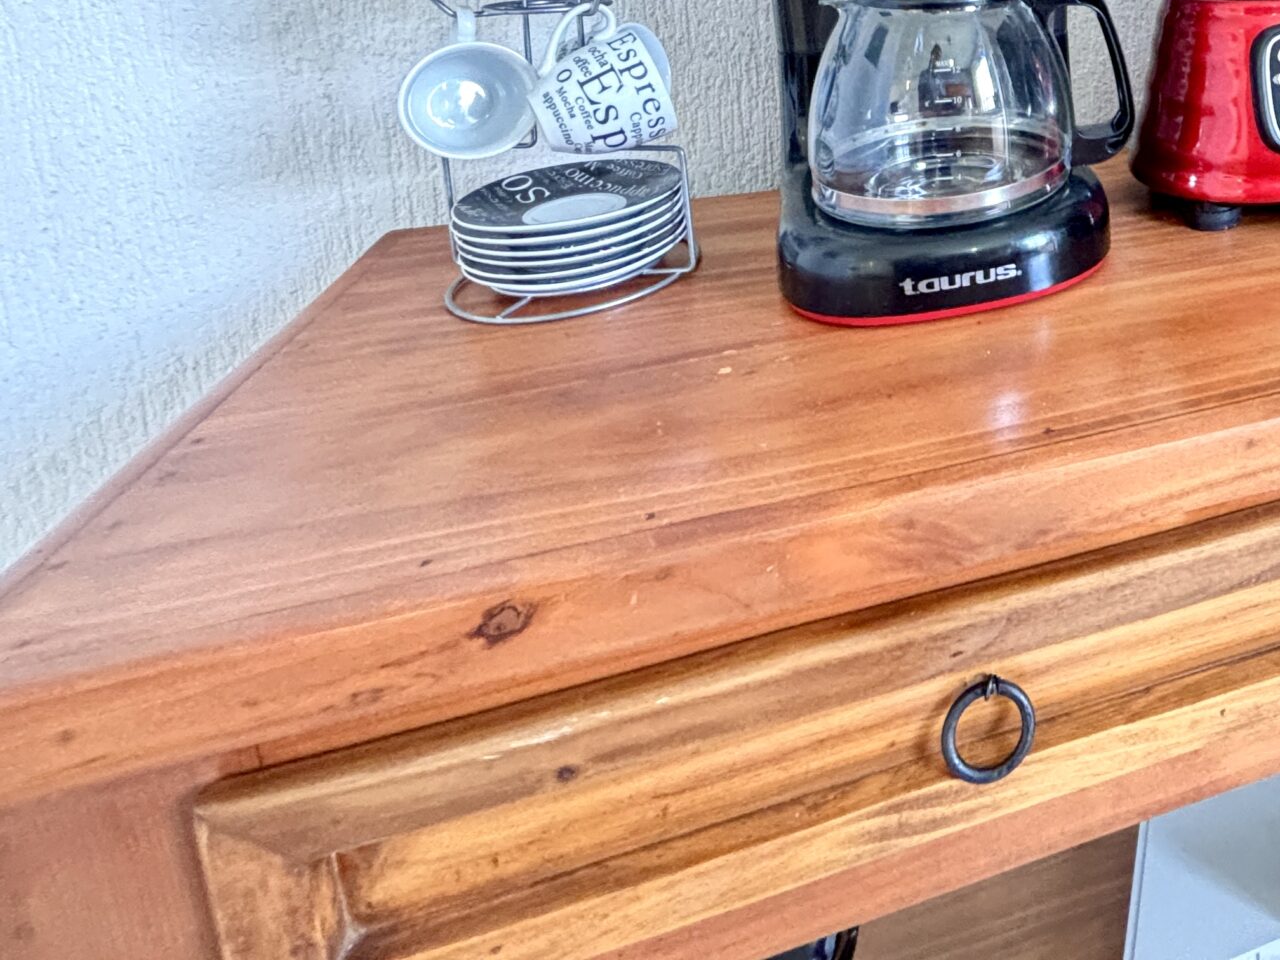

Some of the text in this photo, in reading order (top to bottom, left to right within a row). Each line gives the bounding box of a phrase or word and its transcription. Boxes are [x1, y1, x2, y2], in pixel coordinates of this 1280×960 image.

[555, 86, 576, 119] Mocha
[574, 96, 594, 131] Coffee
[953, 96, 962, 104] 10
